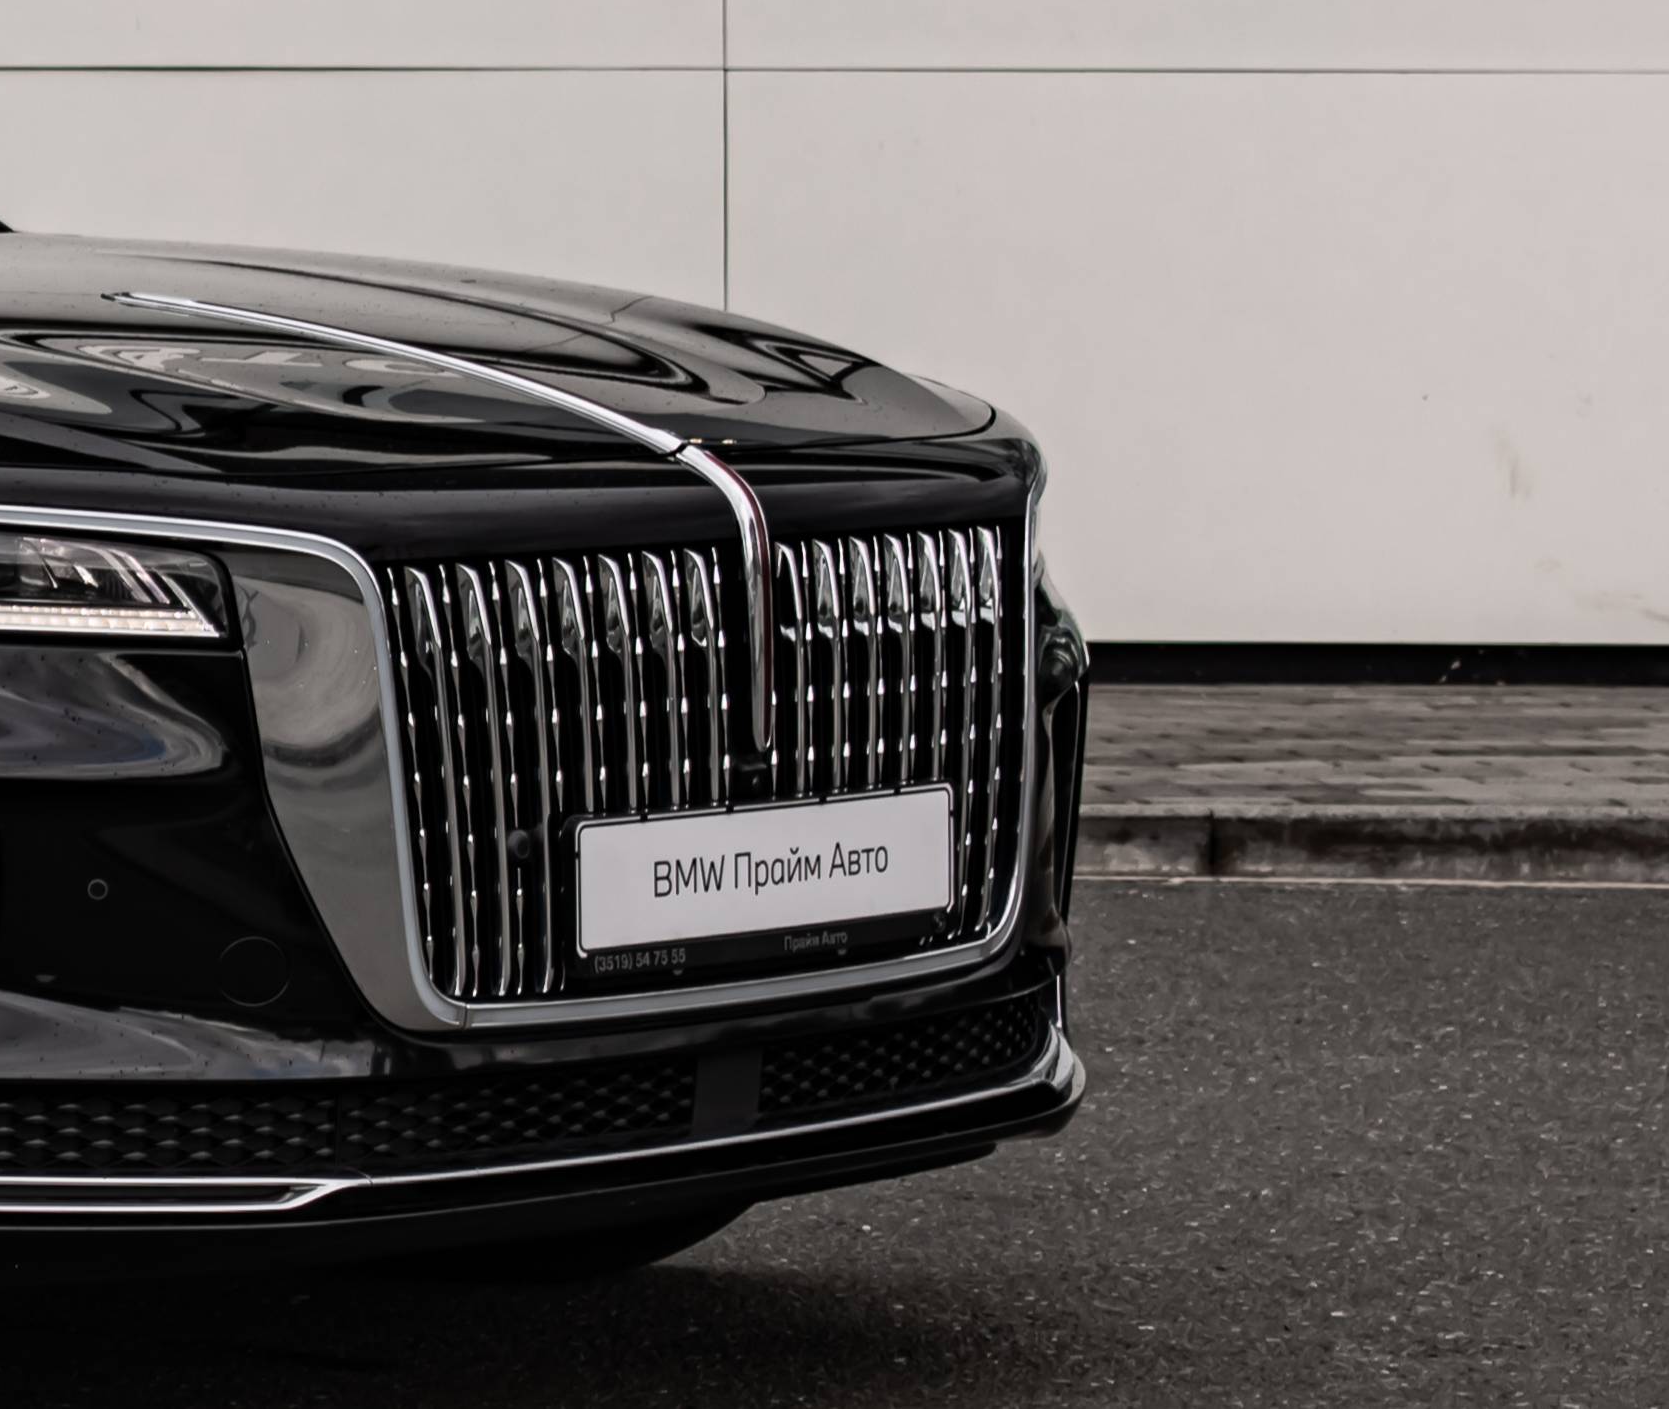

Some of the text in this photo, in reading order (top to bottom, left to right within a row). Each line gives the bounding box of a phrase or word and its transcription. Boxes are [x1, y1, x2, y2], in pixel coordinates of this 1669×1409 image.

[653, 841, 889, 898] BMW Прайм Авто
[594, 947, 686, 974] (3519) 54 75 55
